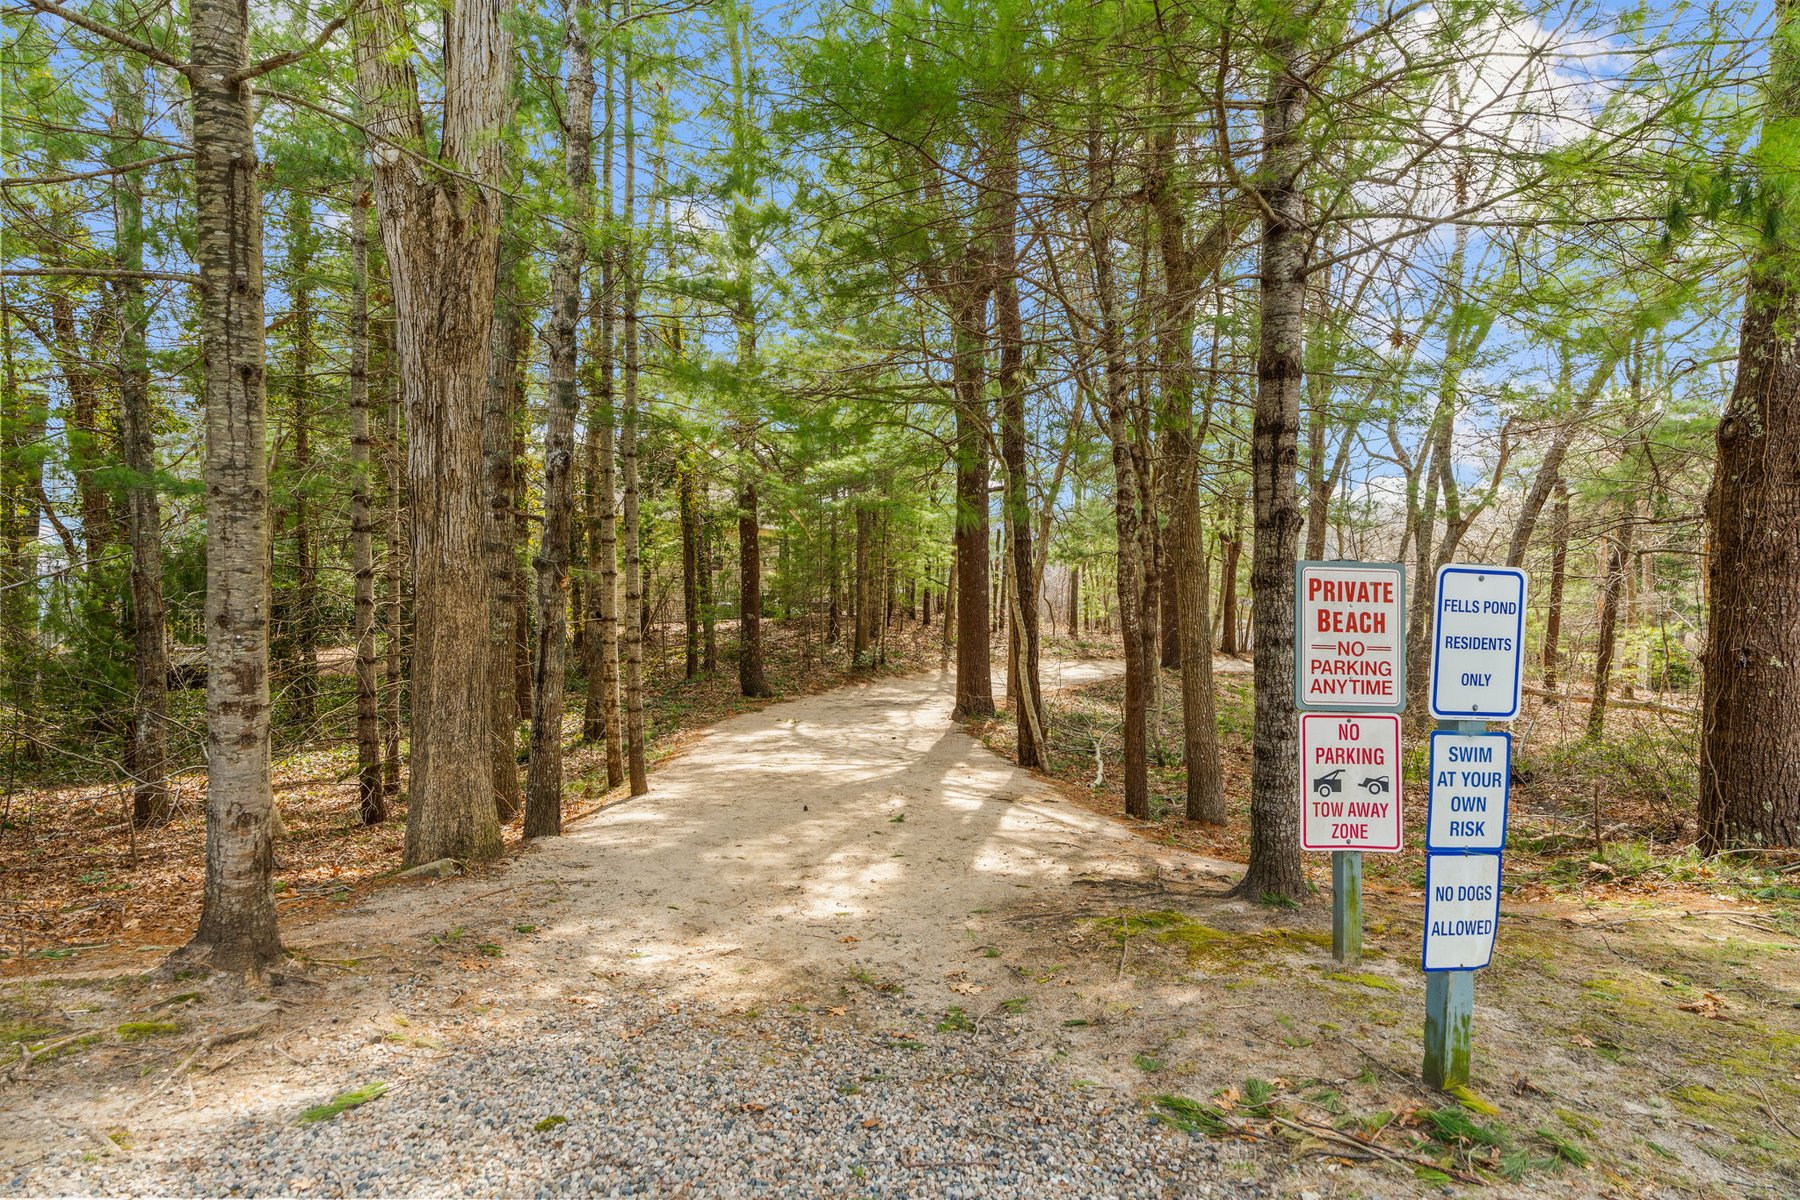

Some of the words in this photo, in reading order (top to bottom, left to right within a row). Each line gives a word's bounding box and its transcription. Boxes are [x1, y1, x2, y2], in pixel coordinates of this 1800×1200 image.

[1309, 578, 1393, 603] PRIVATE
[1444, 599, 1480, 614] FELLS
[1484, 601, 1516, 615] POND
[1317, 609, 1386, 634] BEACH
[1337, 641, 1365, 657] NO
[1445, 636, 1512, 651] RESIDENTS
[1311, 659, 1392, 676] PARKING
[1310, 679, 1393, 695] ANYTIME
[1461, 673, 1492, 687] ONLY
[1338, 723, 1360, 741] NO
[1315, 747, 1384, 765] PARKING
[1448, 746, 1492, 763] SWIM
[1437, 771, 1456, 787] AT
[1461, 771, 1502, 788] YOUR
[1312, 802, 1343, 817] TOW
[1348, 802, 1389, 818] AWAY
[1451, 796, 1487, 812] OWN
[1331, 823, 1368, 839] ZONE
[1450, 821, 1485, 837] RISK
[1435, 886, 1454, 901] NO
[1458, 885, 1492, 901] DOGS
[1431, 919, 1492, 936] ALLOWED
